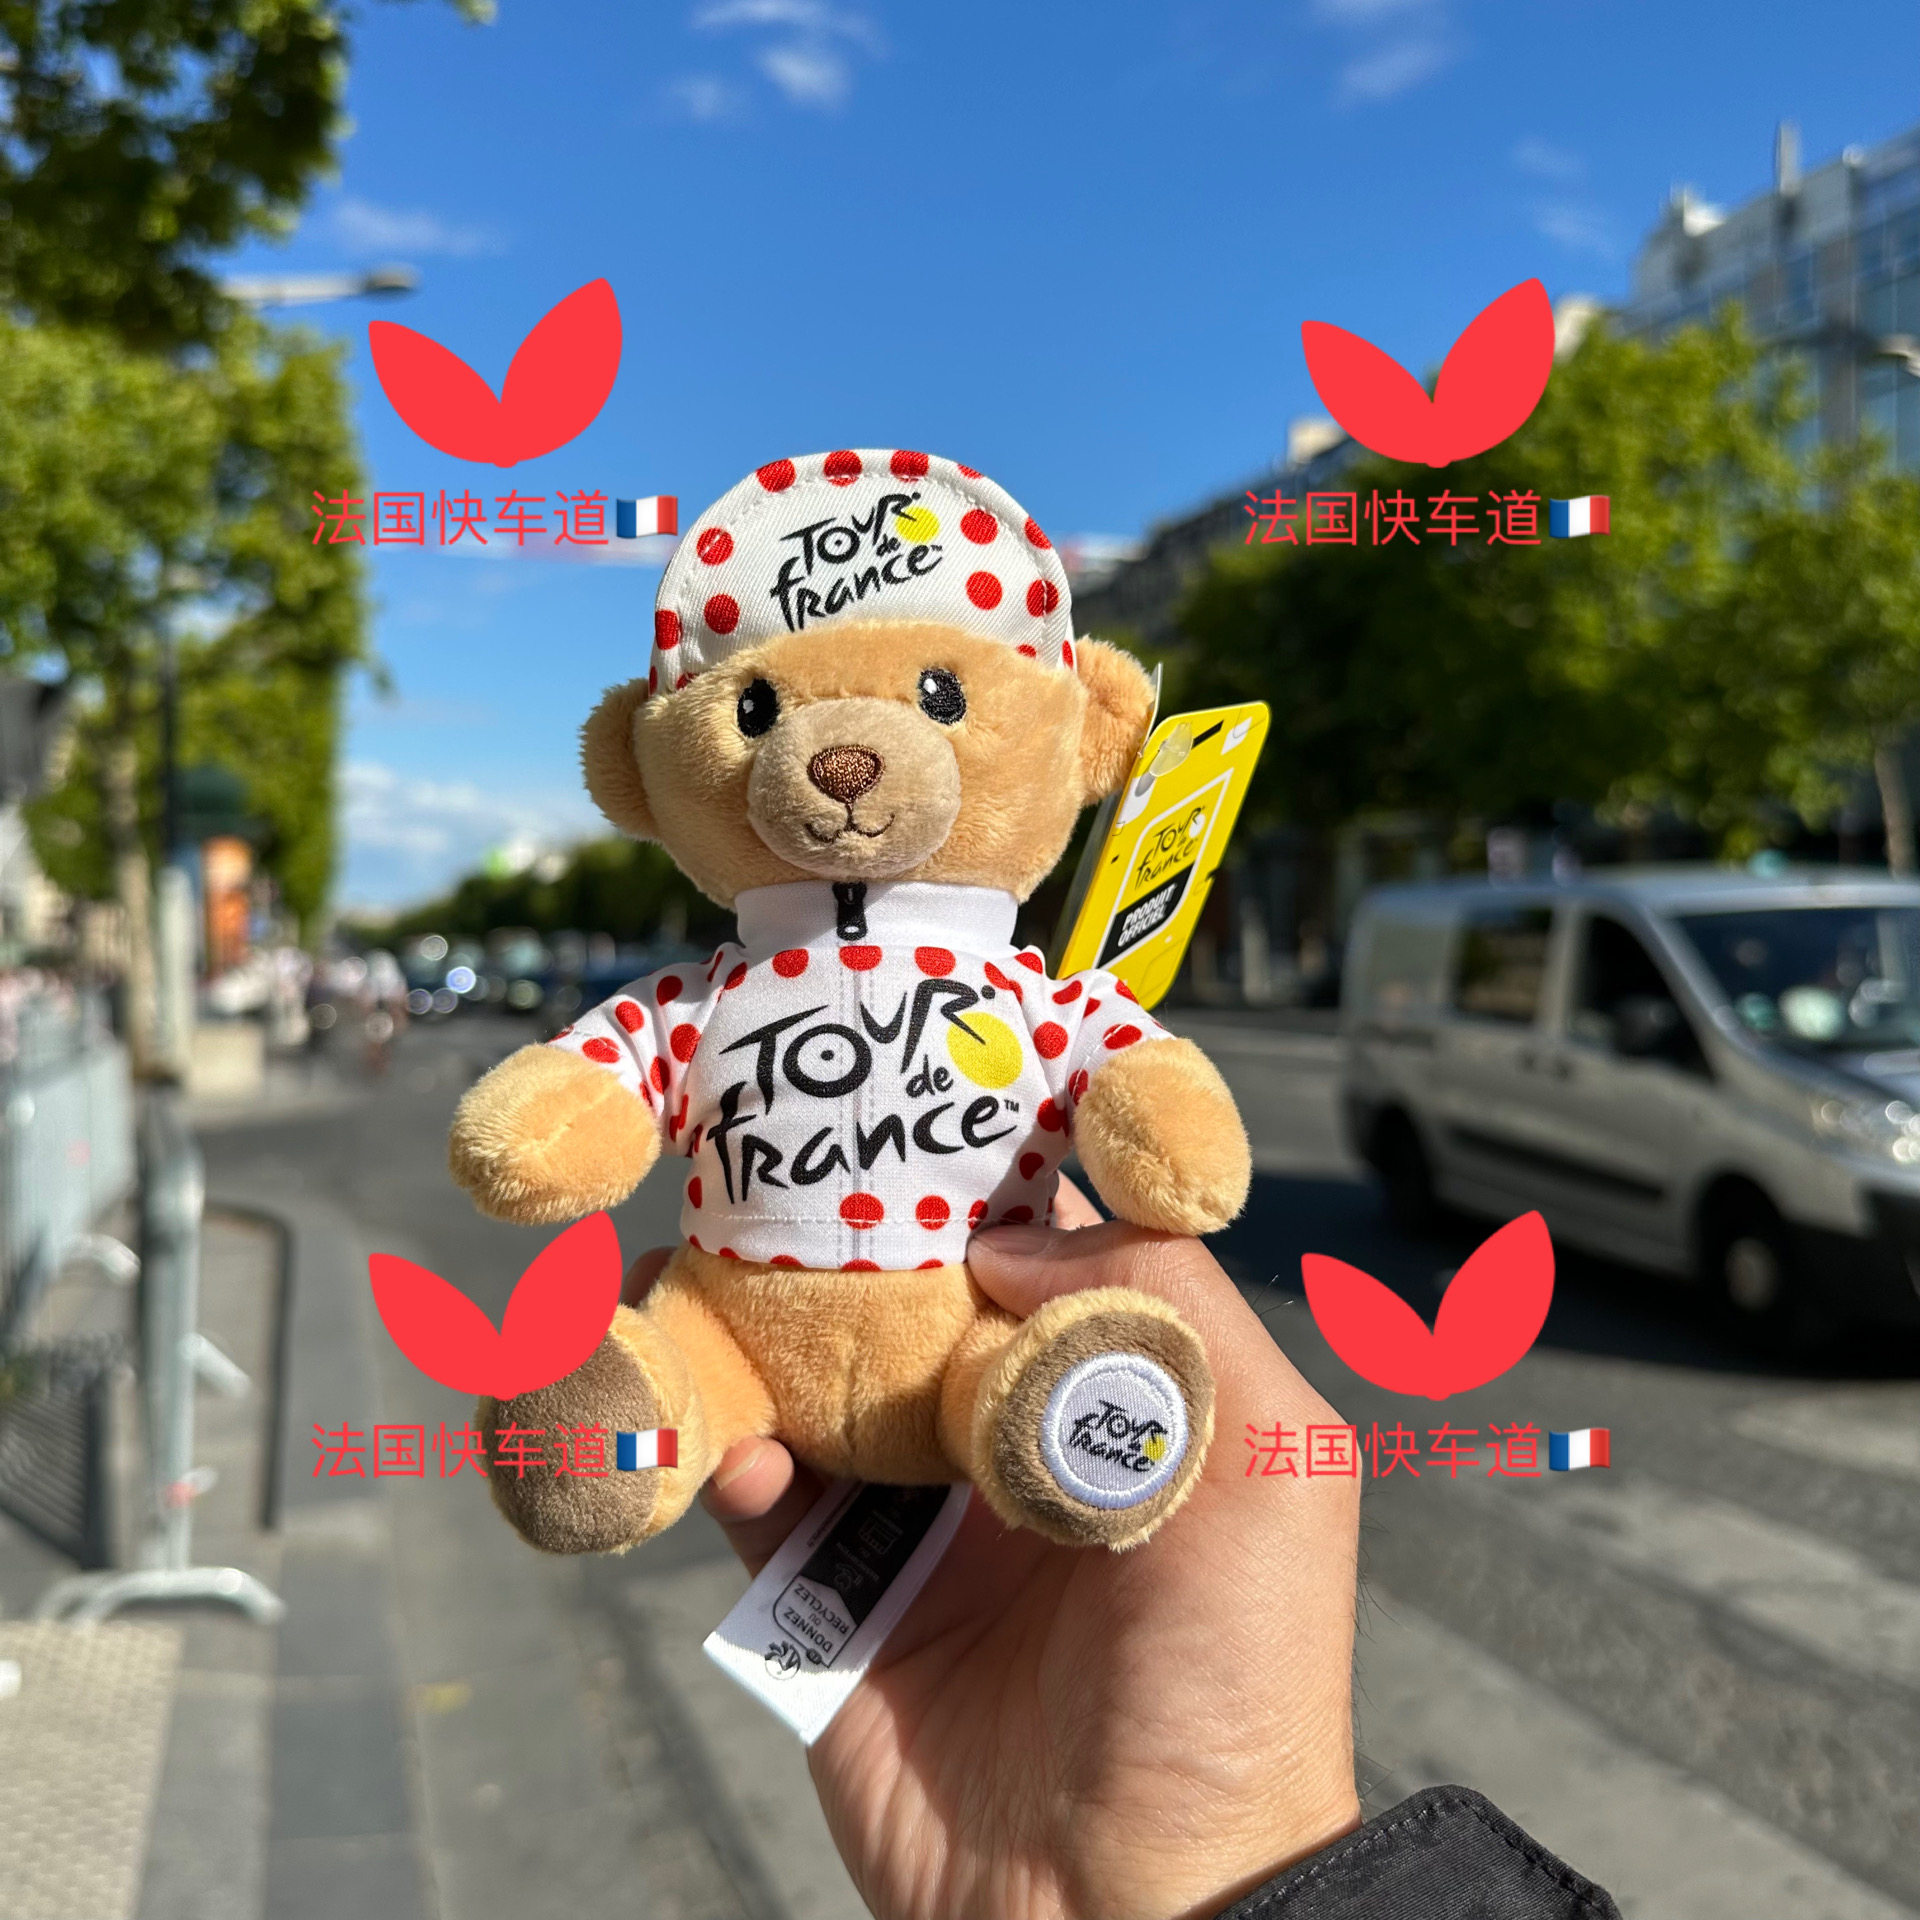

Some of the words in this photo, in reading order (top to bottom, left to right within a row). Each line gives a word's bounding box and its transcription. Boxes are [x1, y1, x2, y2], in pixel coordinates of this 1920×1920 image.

[1117, 904, 1167, 947] OFFICIEL
[1122, 883, 1177, 931] PRODUIT
[905, 1054, 954, 1098] de
[783, 1606, 833, 1653] DONNEZ
[794, 1583, 850, 1634] RECYCLEZ
[808, 1613, 822, 1626] OU
